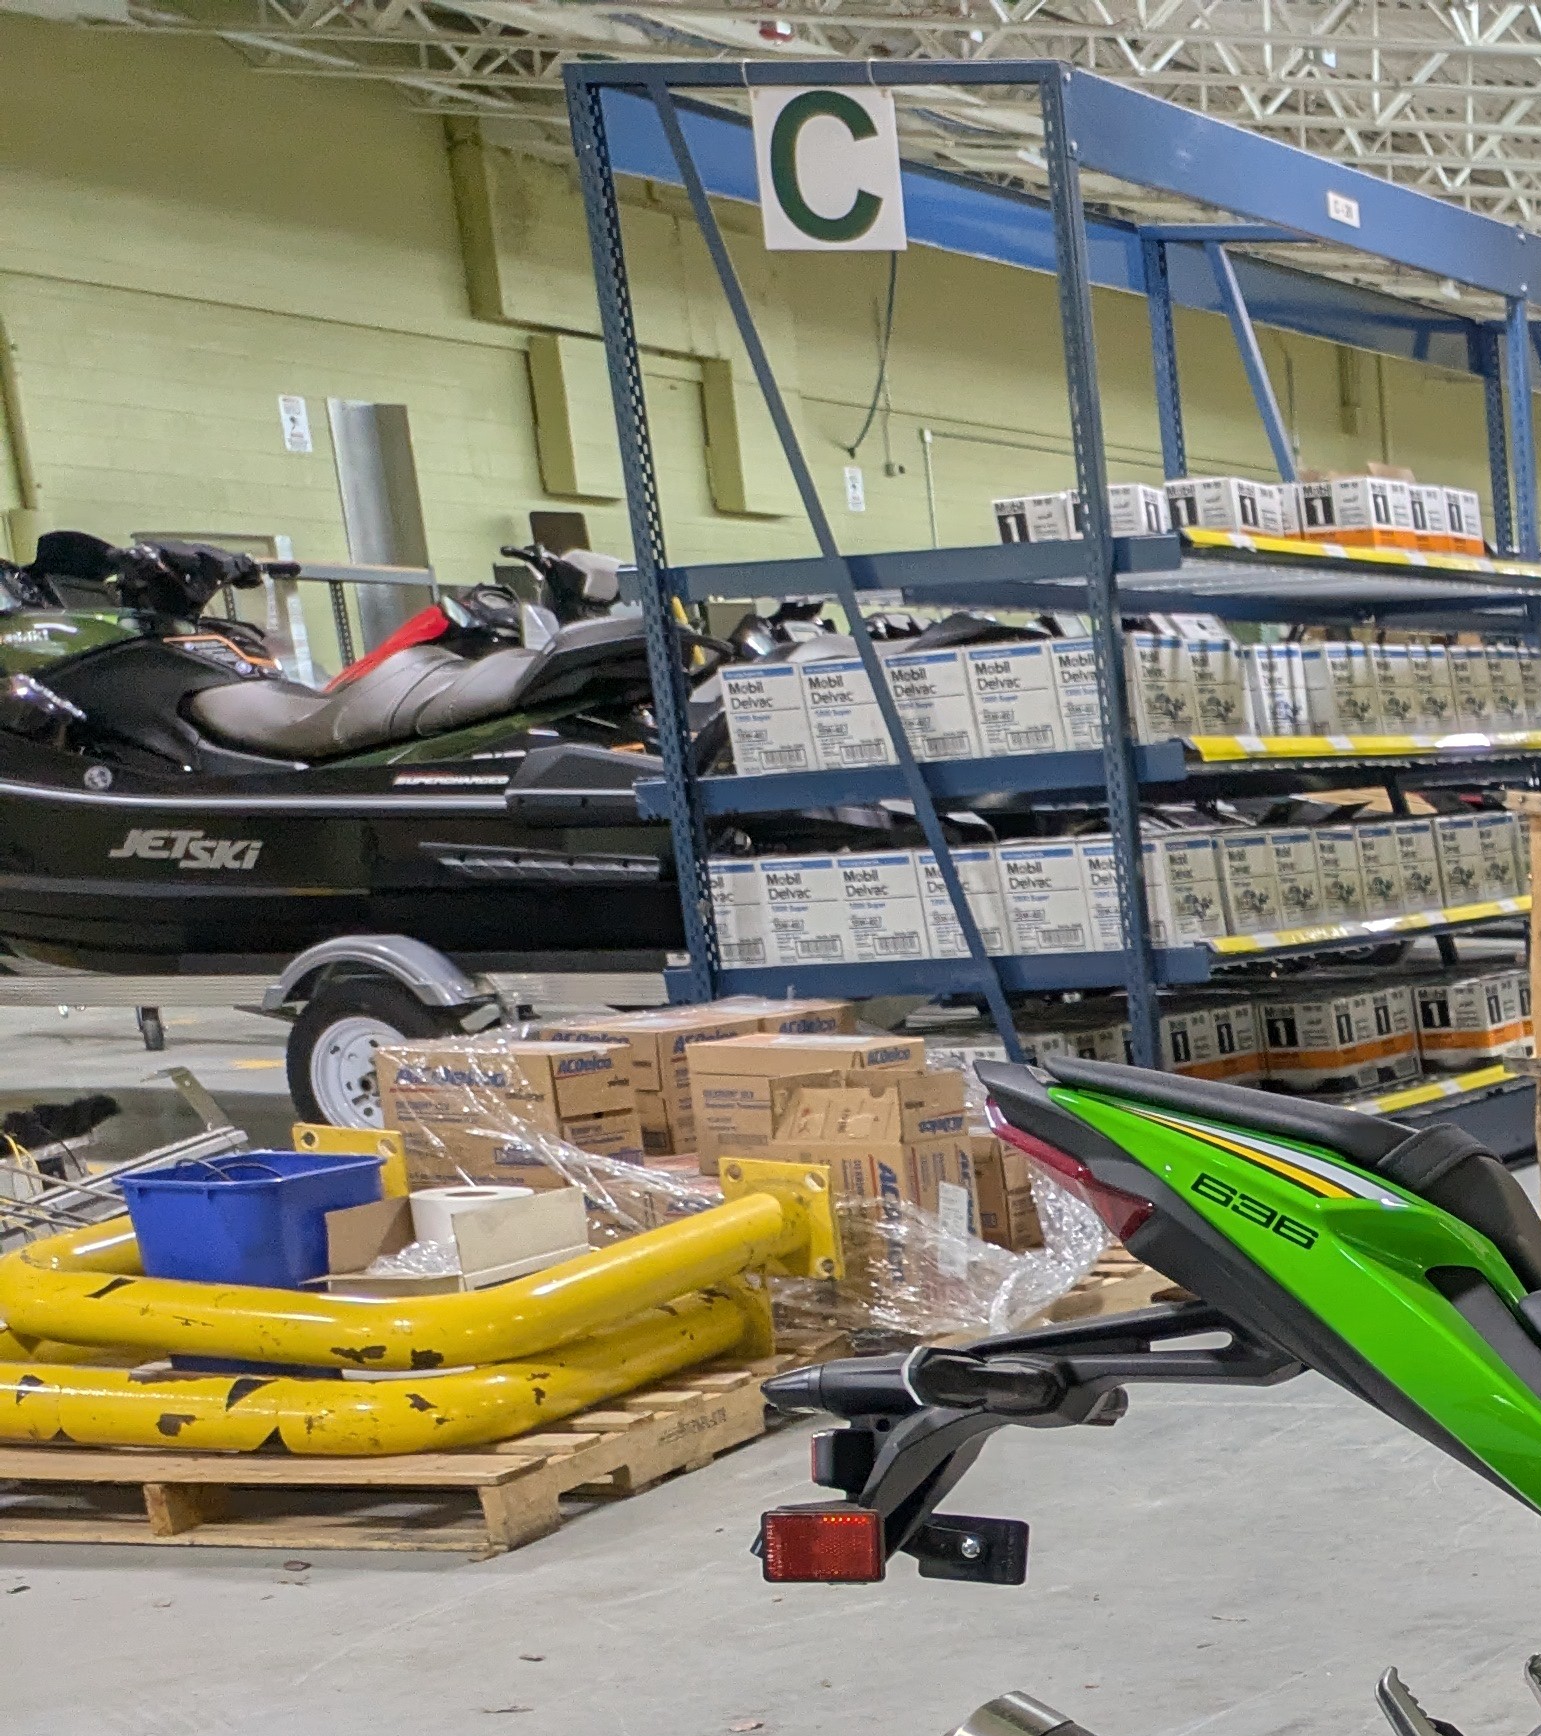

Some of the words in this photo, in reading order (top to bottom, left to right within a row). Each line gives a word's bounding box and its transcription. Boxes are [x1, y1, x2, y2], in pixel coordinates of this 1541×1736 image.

[771, 90, 883, 242] C
[890, 667, 927, 682] Mobil
[974, 661, 1010, 675] Mobil
[728, 681, 764, 695] Mobil
[808, 675, 844, 690] Mobil
[976, 677, 1020, 691] Delvac
[893, 682, 937, 698] Delvac
[730, 696, 773, 710] Delvac
[810, 691, 853, 705] Delvac
[1007, 861, 1043, 875] Mobil
[766, 873, 802, 886] Mobil
[843, 869, 879, 883] Mobil
[1009, 876, 1052, 890] Delvac
[768, 887, 812, 900] Delvac
[845, 884, 889, 897] Delvac
[1191, 1172, 1319, 1250] 636
